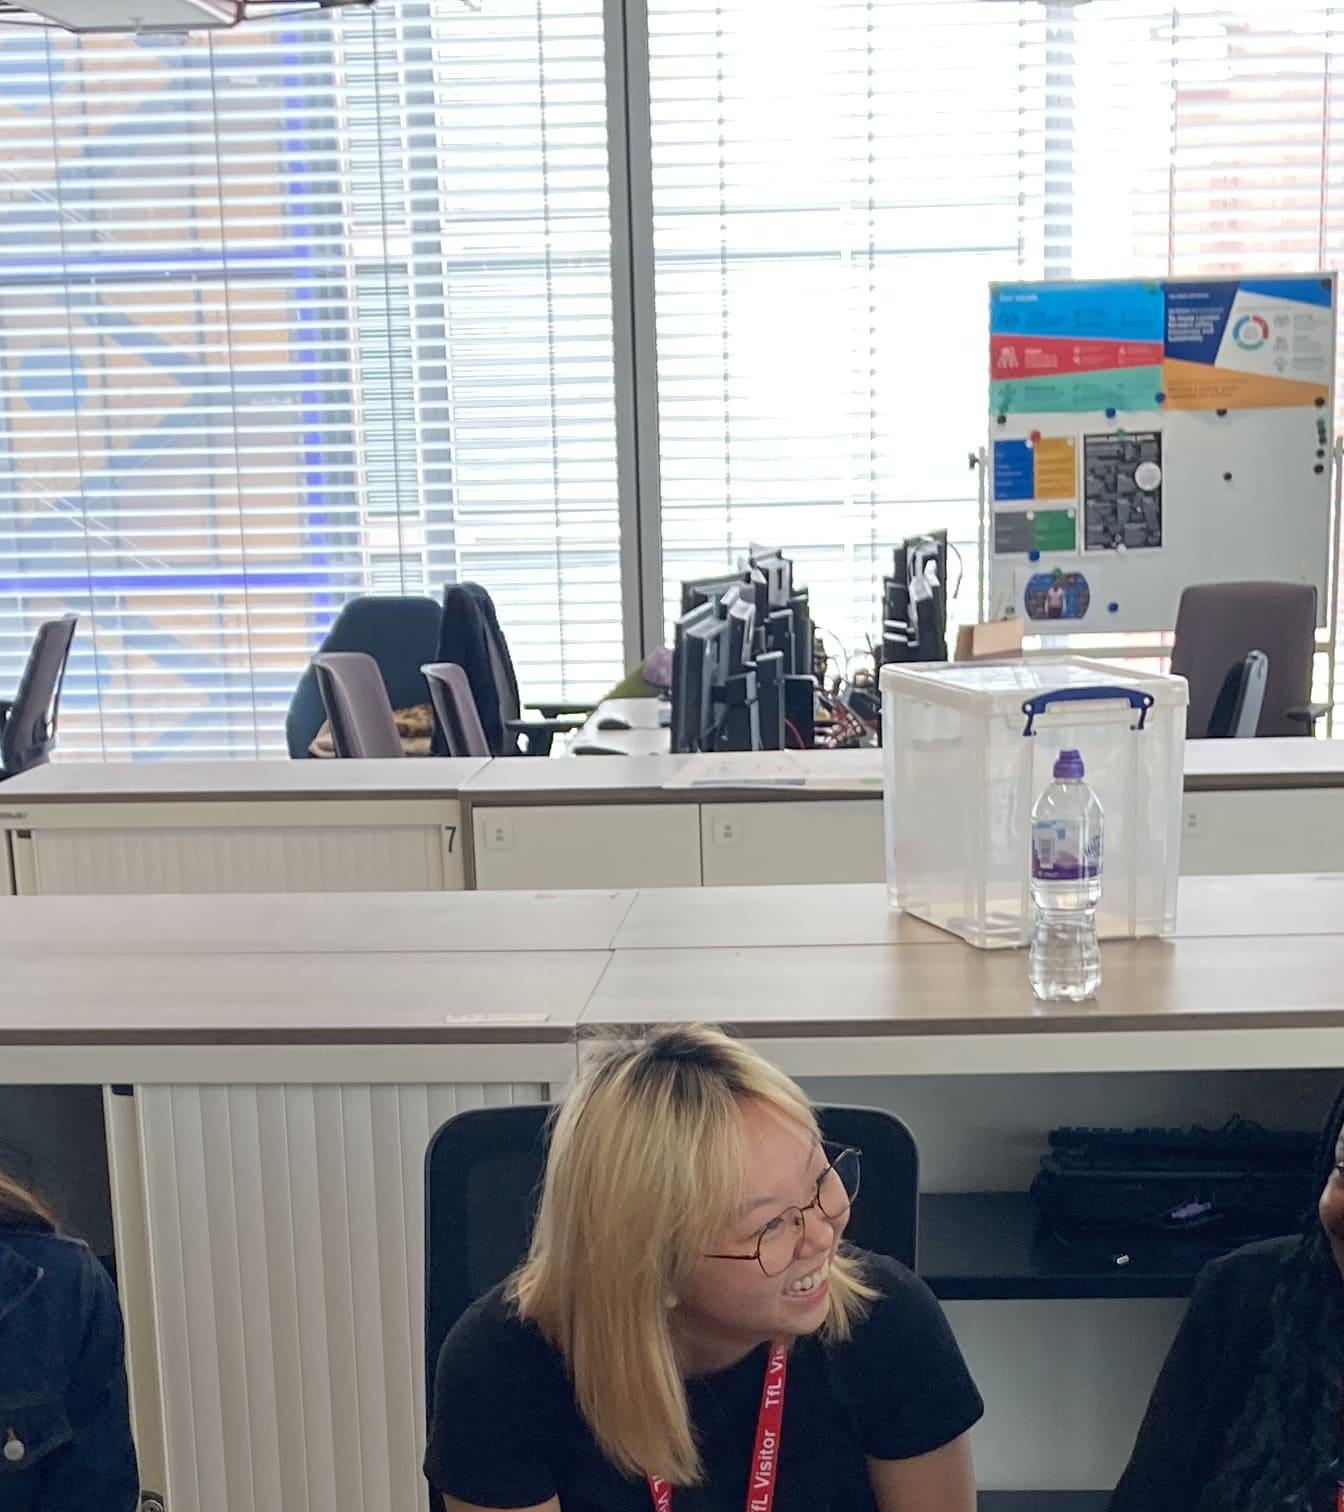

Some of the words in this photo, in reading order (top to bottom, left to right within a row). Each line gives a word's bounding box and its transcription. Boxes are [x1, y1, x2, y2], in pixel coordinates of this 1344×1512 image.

[445, 826, 456, 853] 7
[765, 1377, 781, 1408] TfL
[754, 1429, 776, 1488] Visitor
